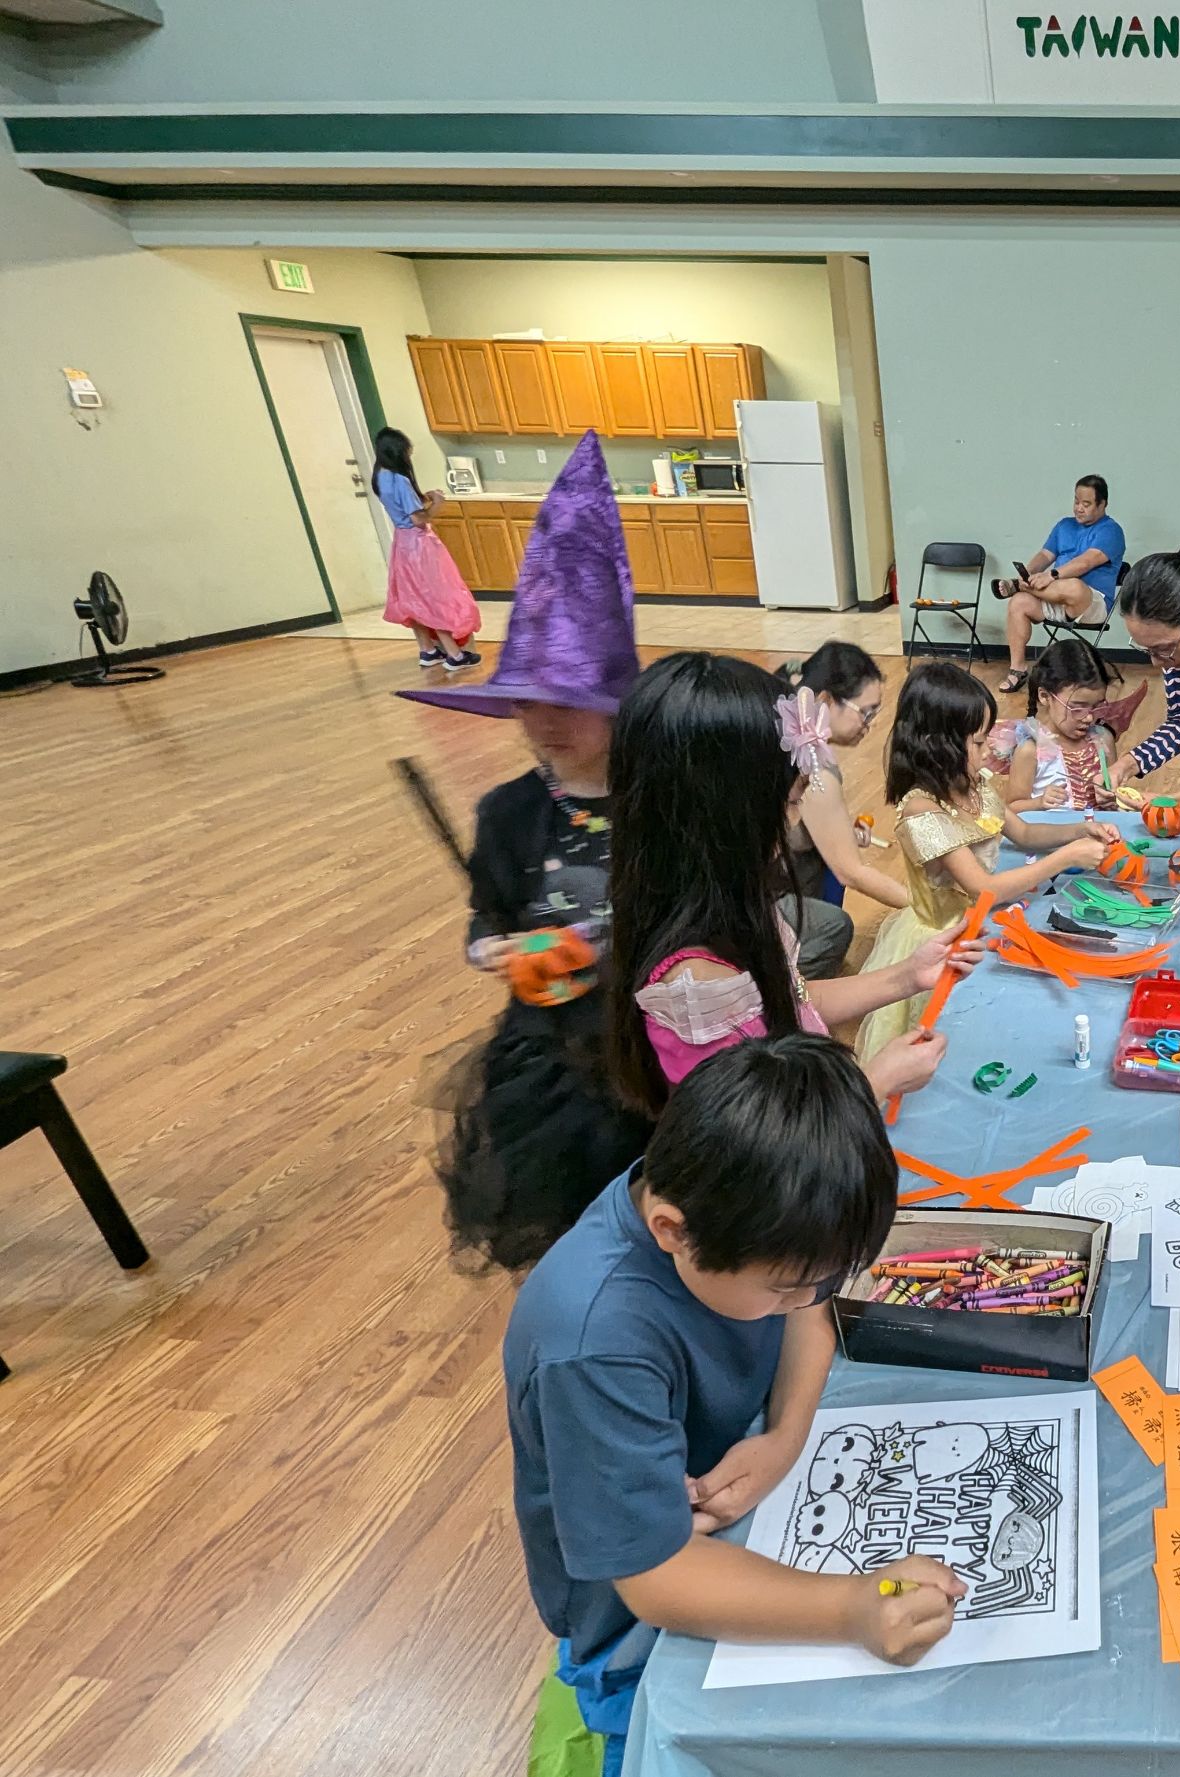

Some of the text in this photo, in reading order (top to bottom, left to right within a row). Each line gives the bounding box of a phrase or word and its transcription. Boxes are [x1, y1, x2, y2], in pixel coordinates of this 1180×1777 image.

[1016, 15, 1179, 58] TAIWAN
[280, 263, 307, 288] EXIT
[861, 1464, 913, 1570] WEEN
[951, 1472, 995, 1582] HAPPY
